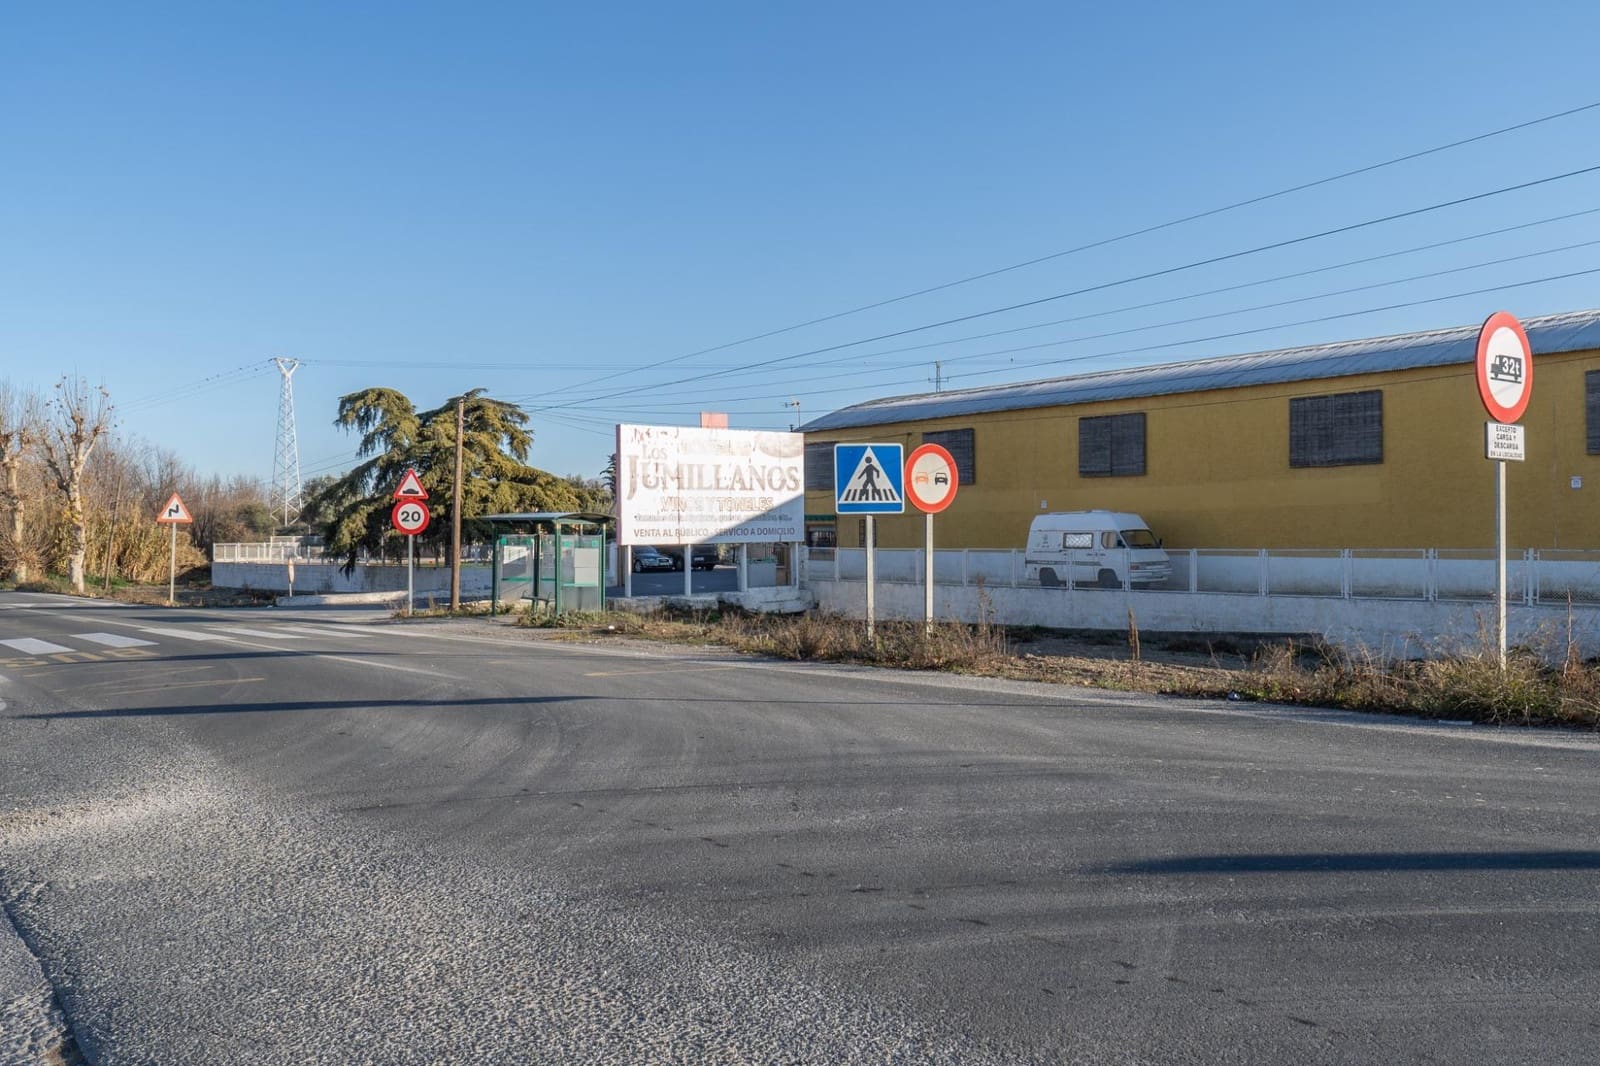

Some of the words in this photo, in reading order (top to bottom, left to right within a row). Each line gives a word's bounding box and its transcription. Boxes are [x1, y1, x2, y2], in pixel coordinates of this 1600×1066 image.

[1502, 357, 1520, 375] 32t
[1494, 441, 1518, 450] DESCARGA
[627, 455, 801, 501] JUMILLANOS
[401, 510, 421, 522] 20
[633, 528, 661, 537] VENTA
[662, 528, 674, 537] AL
[715, 527, 749, 537] SERVICIO
[750, 527, 756, 536] A
[757, 527, 796, 536] DOMICILIO
